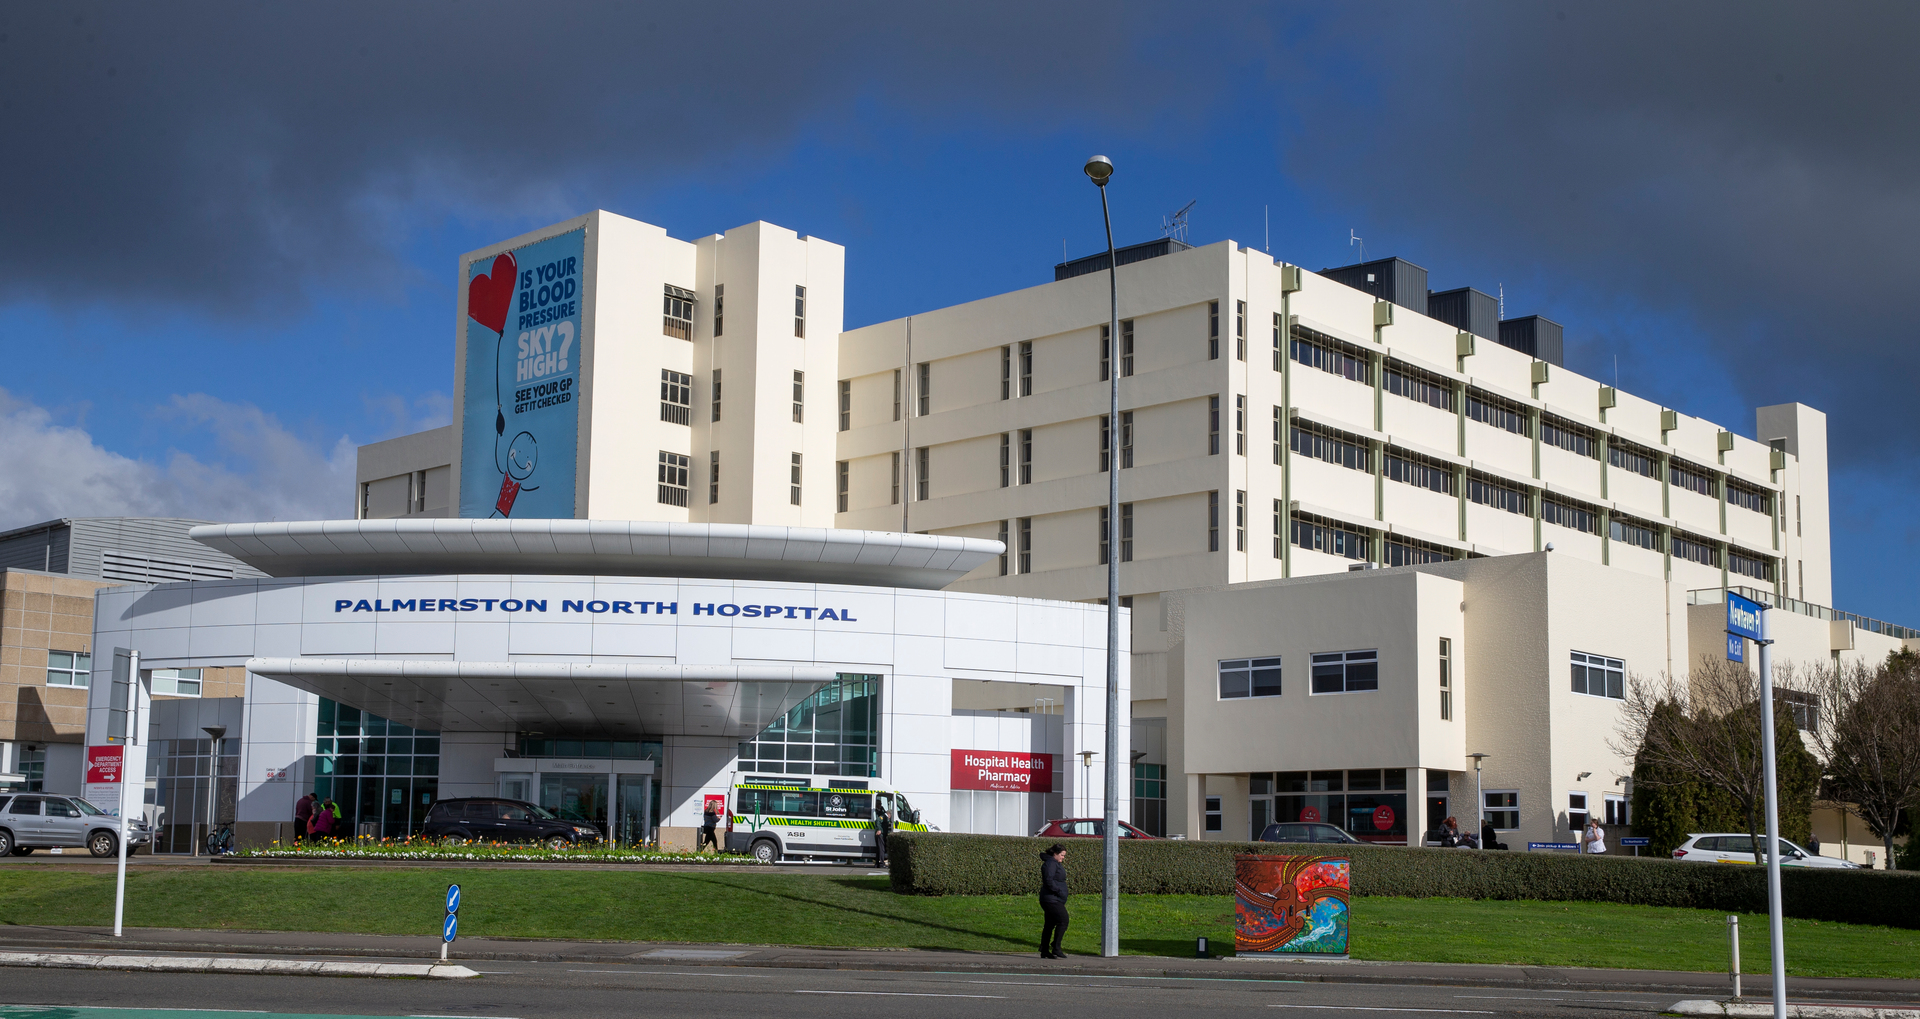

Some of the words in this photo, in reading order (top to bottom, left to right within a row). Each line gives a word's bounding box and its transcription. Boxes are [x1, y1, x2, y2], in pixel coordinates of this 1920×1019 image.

[520, 269, 533, 291] IS
[536, 256, 576, 285] YOUR
[519, 277, 576, 313] BLOOD
[518, 300, 576, 331] PRESSURE
[515, 388, 532, 403] SEE
[533, 381, 558, 398] YOUR
[560, 378, 573, 392] GP
[514, 402, 529, 414] GET
[529, 400, 537, 411] IT
[537, 392, 571, 409] CHECKED
[334, 598, 548, 613] PALMERSTON
[562, 599, 678, 615] NORTH
[693, 602, 858, 622] HOSPITAL
[1729, 599, 1755, 632] Newhaven
[1755, 609, 1761, 634] Pl
[1729, 638, 1734, 654] No
[1734, 640, 1742, 656] Exit
[964, 754, 1009, 770] Hospital
[1011, 757, 1044, 770] Health
[978, 769, 1031, 785] Pharmacy
